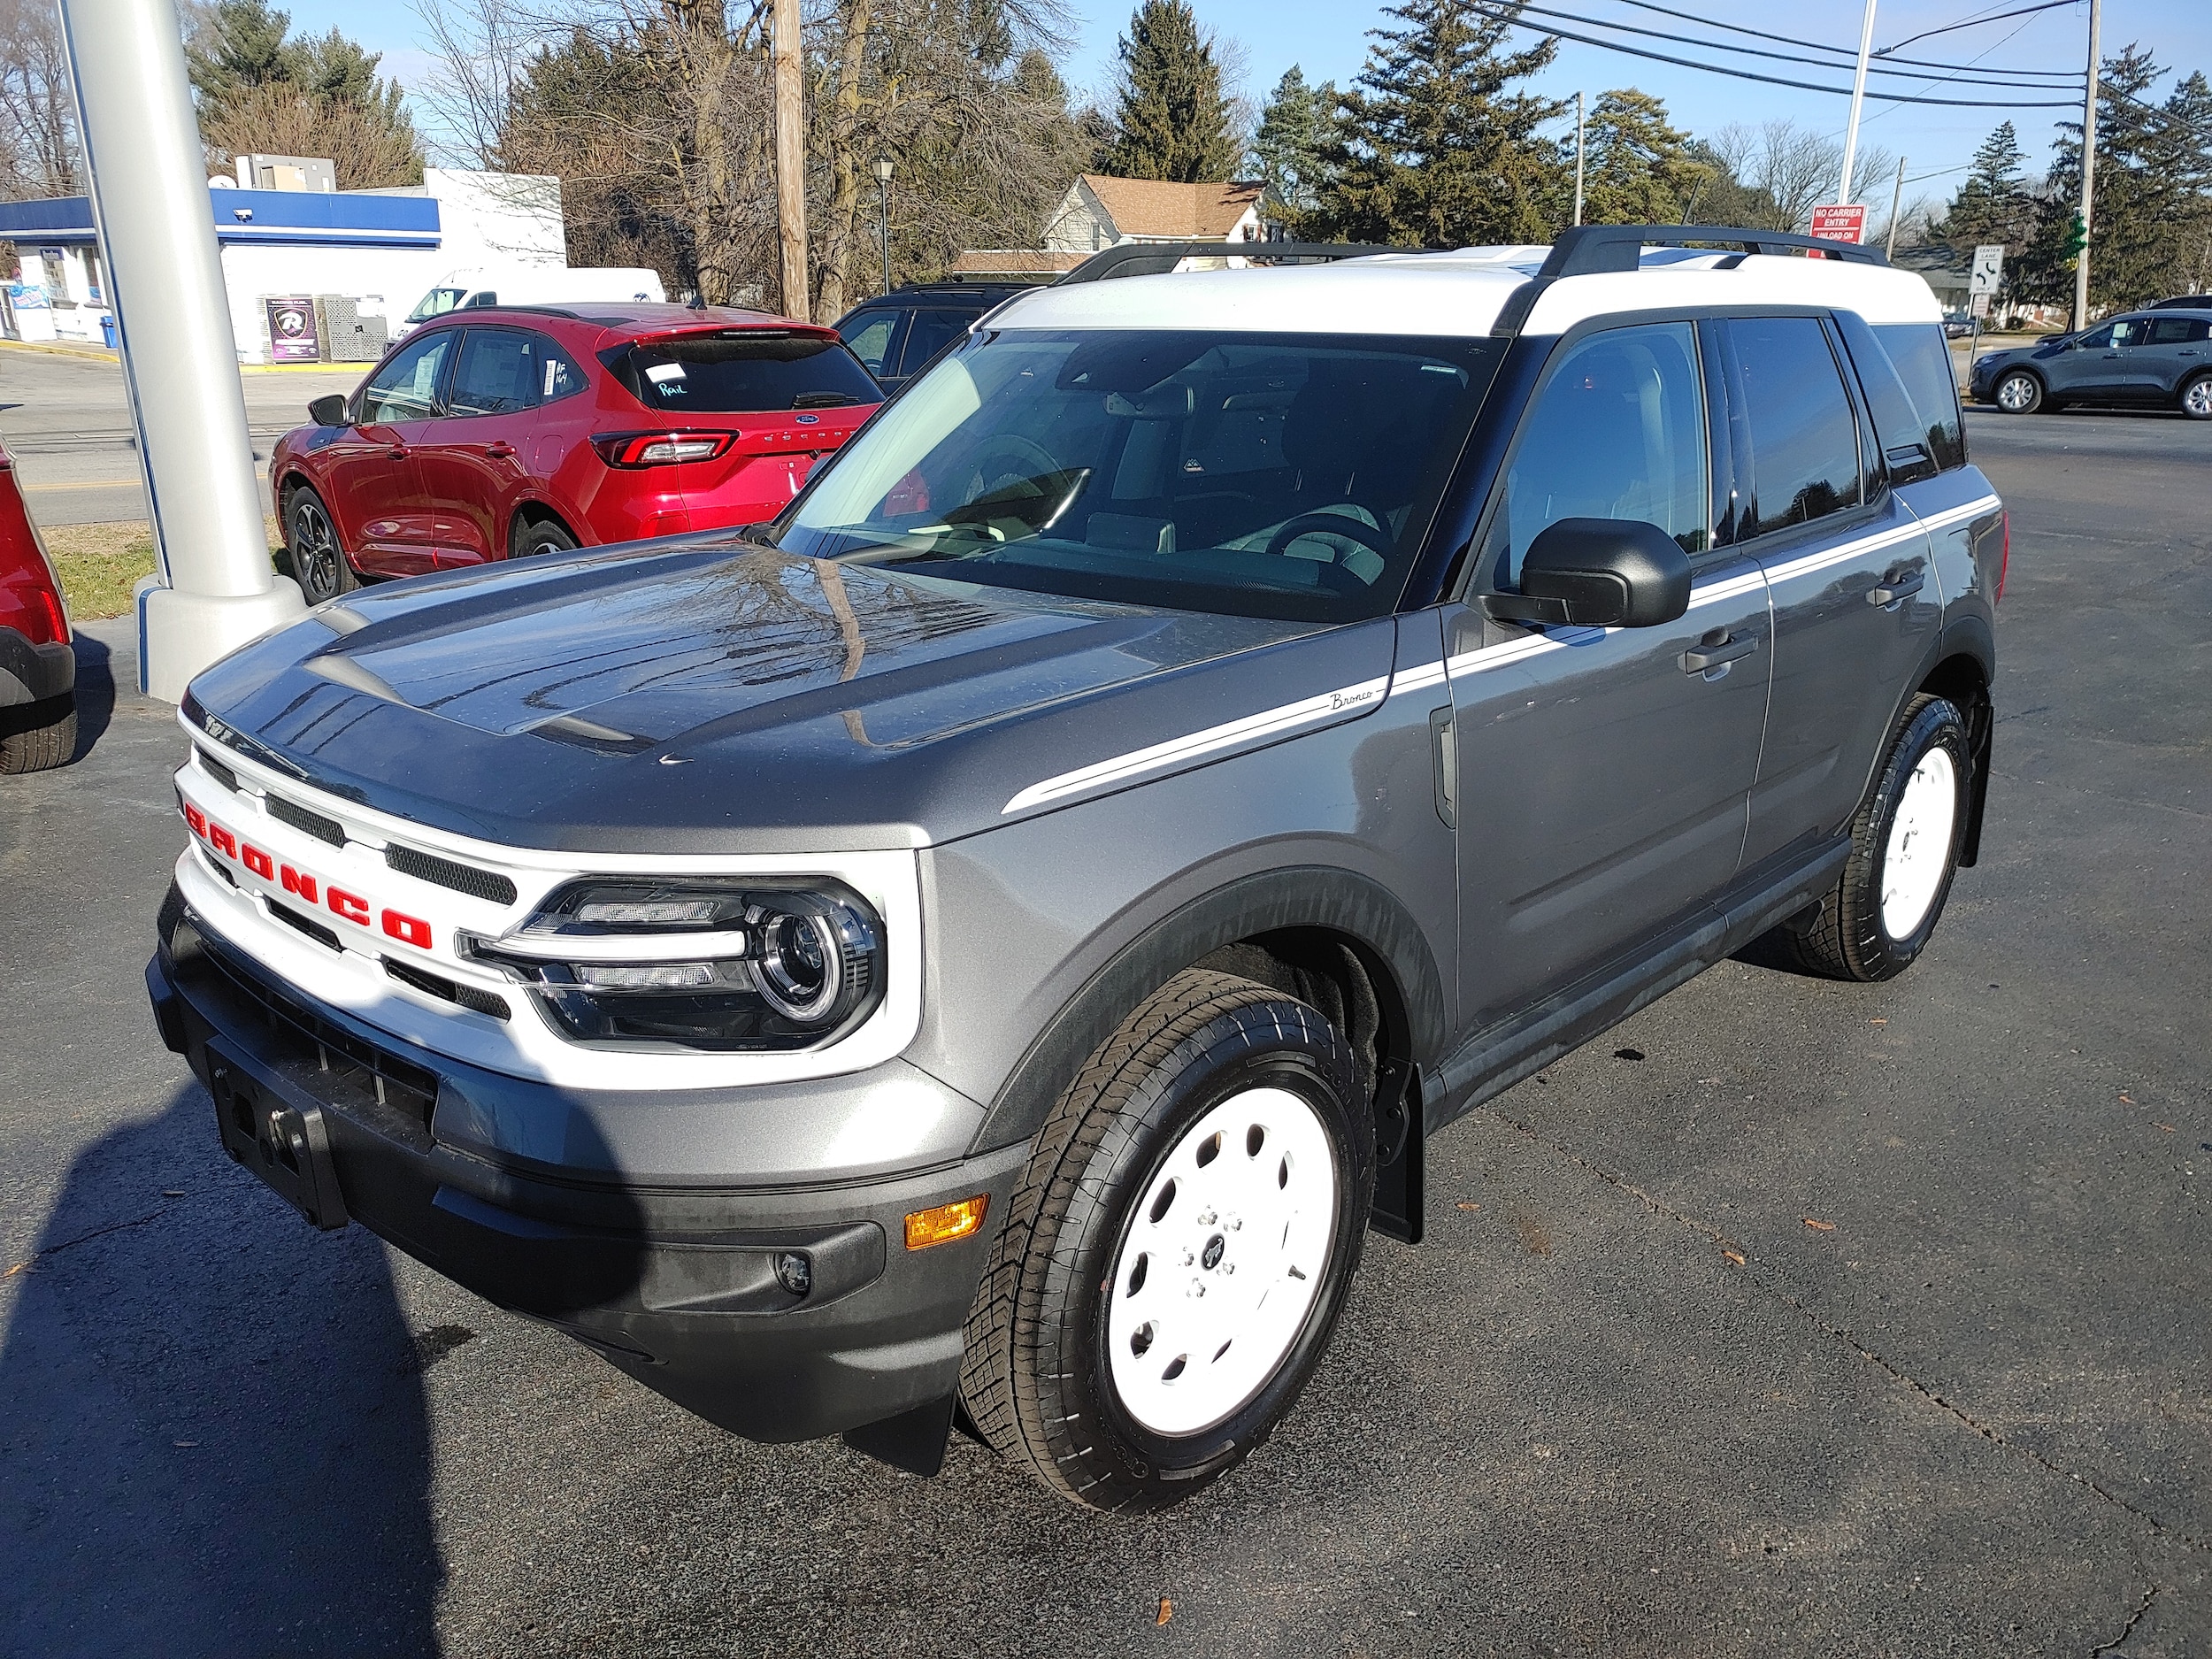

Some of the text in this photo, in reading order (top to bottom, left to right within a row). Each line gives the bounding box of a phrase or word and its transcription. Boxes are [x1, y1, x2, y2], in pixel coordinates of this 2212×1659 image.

[1816, 208, 1862, 218] NO CARRIER
[1824, 219, 1850, 227] ENTRY
[1330, 691, 1373, 710] Bronco
[184, 801, 433, 949] BRONCO
